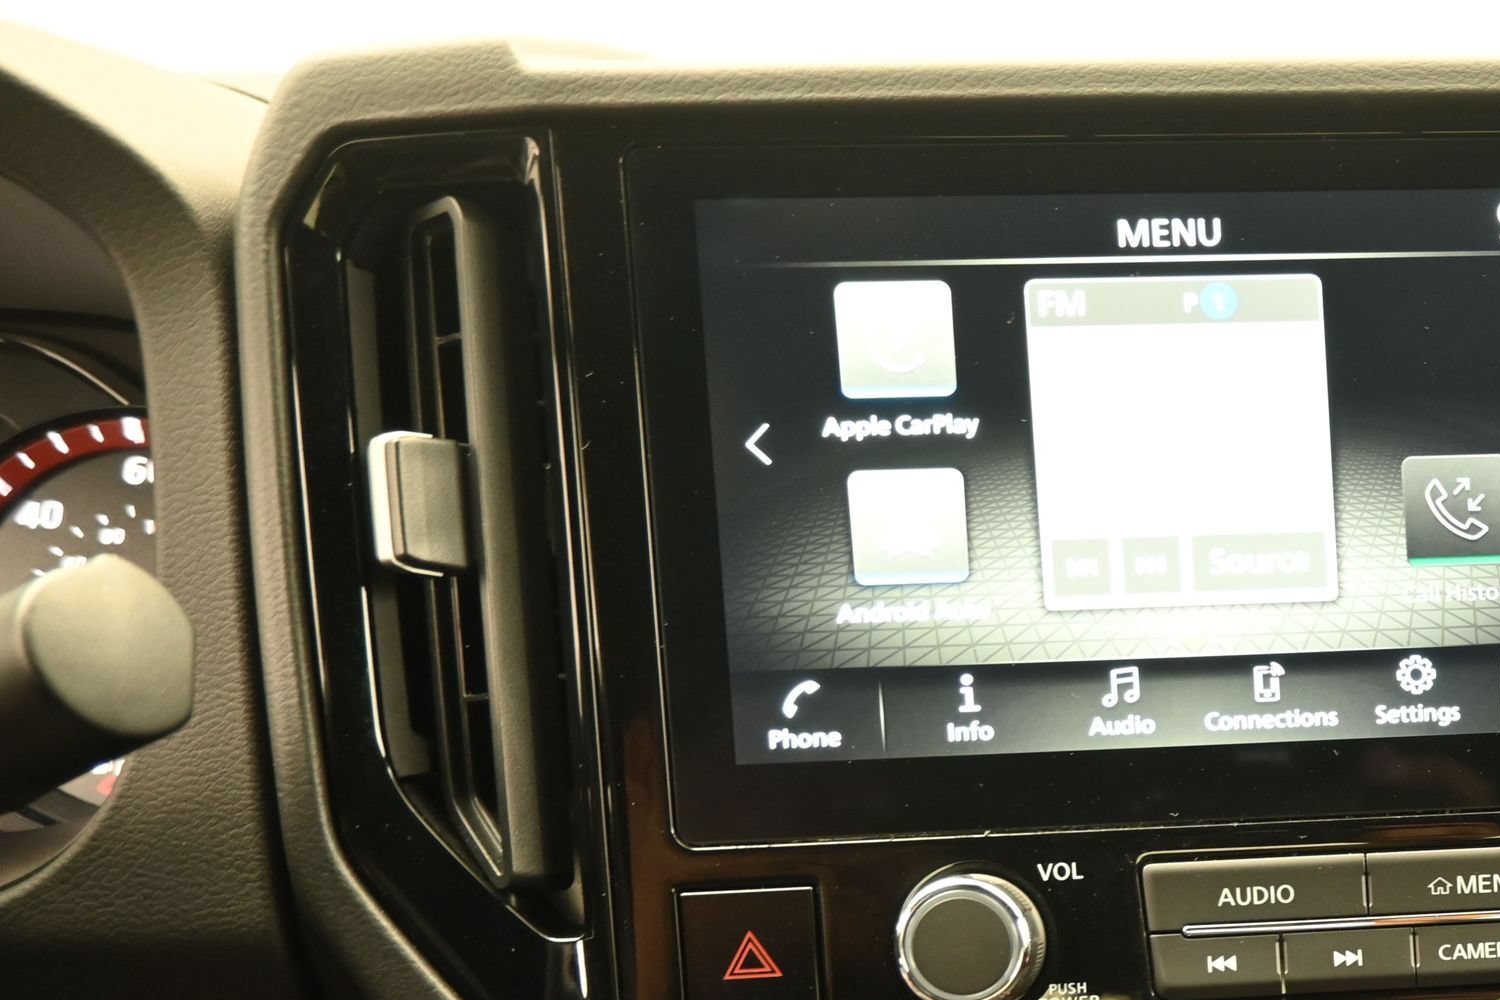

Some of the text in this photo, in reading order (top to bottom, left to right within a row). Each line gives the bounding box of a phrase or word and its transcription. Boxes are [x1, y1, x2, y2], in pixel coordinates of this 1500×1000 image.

[1116, 217, 1222, 248] MENU
[1036, 288, 1086, 318] FM
[821, 412, 980, 442] Apple CarPlay
[14, 500, 64, 529] 40
[1208, 546, 1311, 577] Source
[835, 599, 931, 625] Android
[1088, 714, 1157, 737] Audio
[1204, 708, 1339, 732] Connections
[1375, 703, 1461, 728] Settings
[768, 728, 842, 750] Phone
[946, 722, 995, 744] Info
[1036, 862, 1085, 882] VOL
[1217, 884, 1295, 907] AUDIO
[1049, 982, 1088, 994] PUSH
